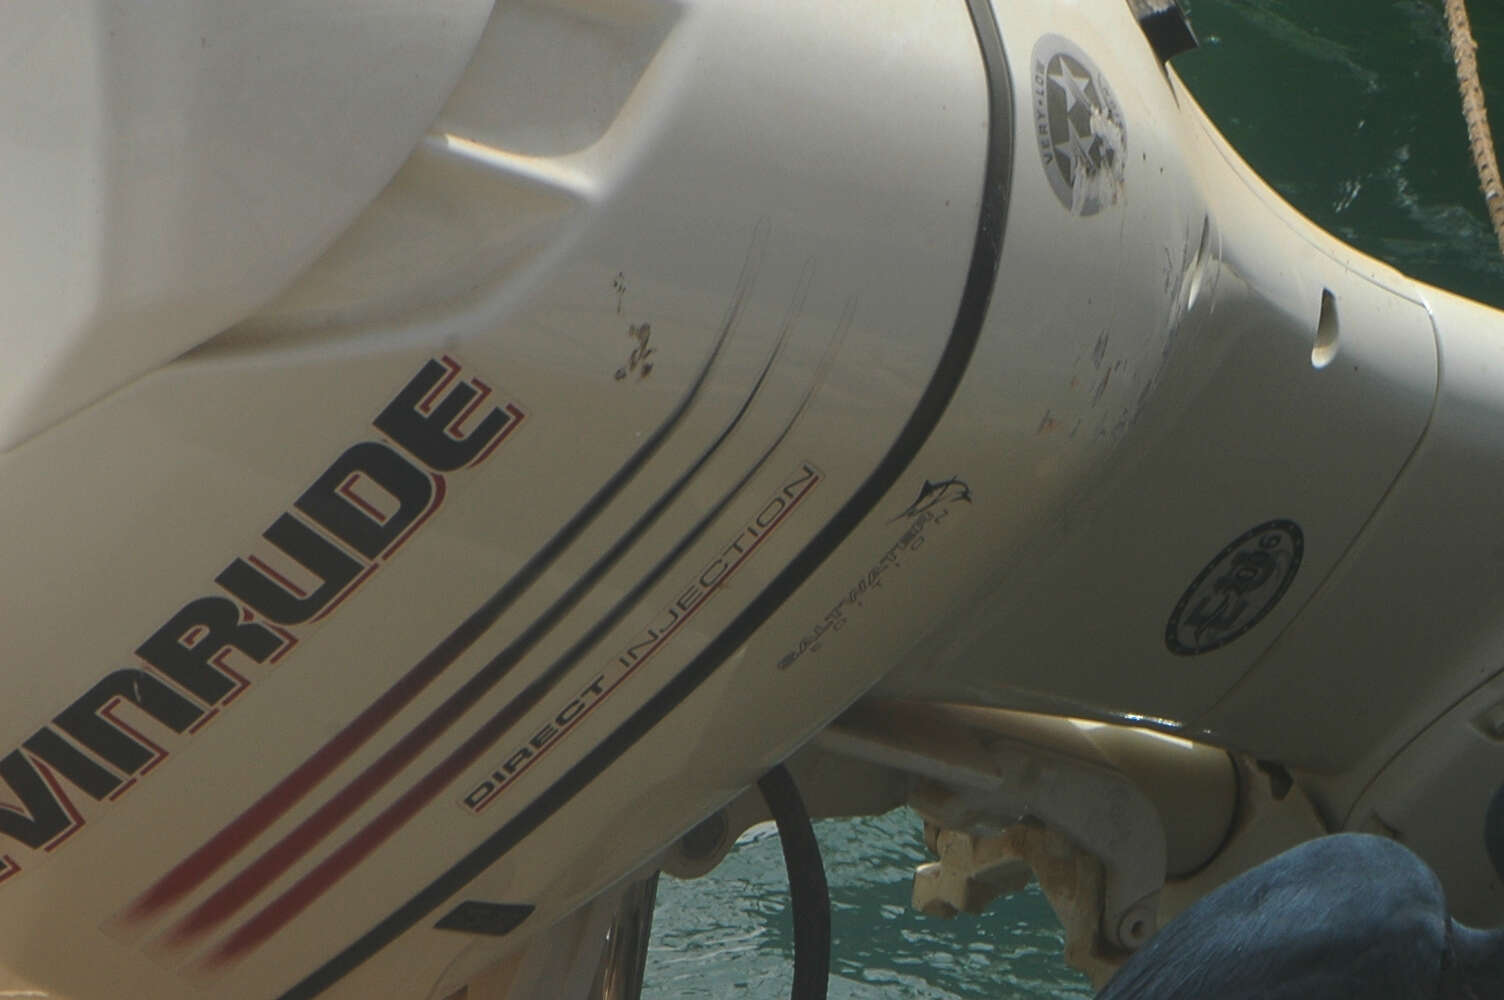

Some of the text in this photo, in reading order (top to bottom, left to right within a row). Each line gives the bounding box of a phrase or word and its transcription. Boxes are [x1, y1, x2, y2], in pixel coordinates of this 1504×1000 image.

[0, 355, 525, 883] VINRUDE
[464, 464, 817, 808] DIRECT INJECTION
